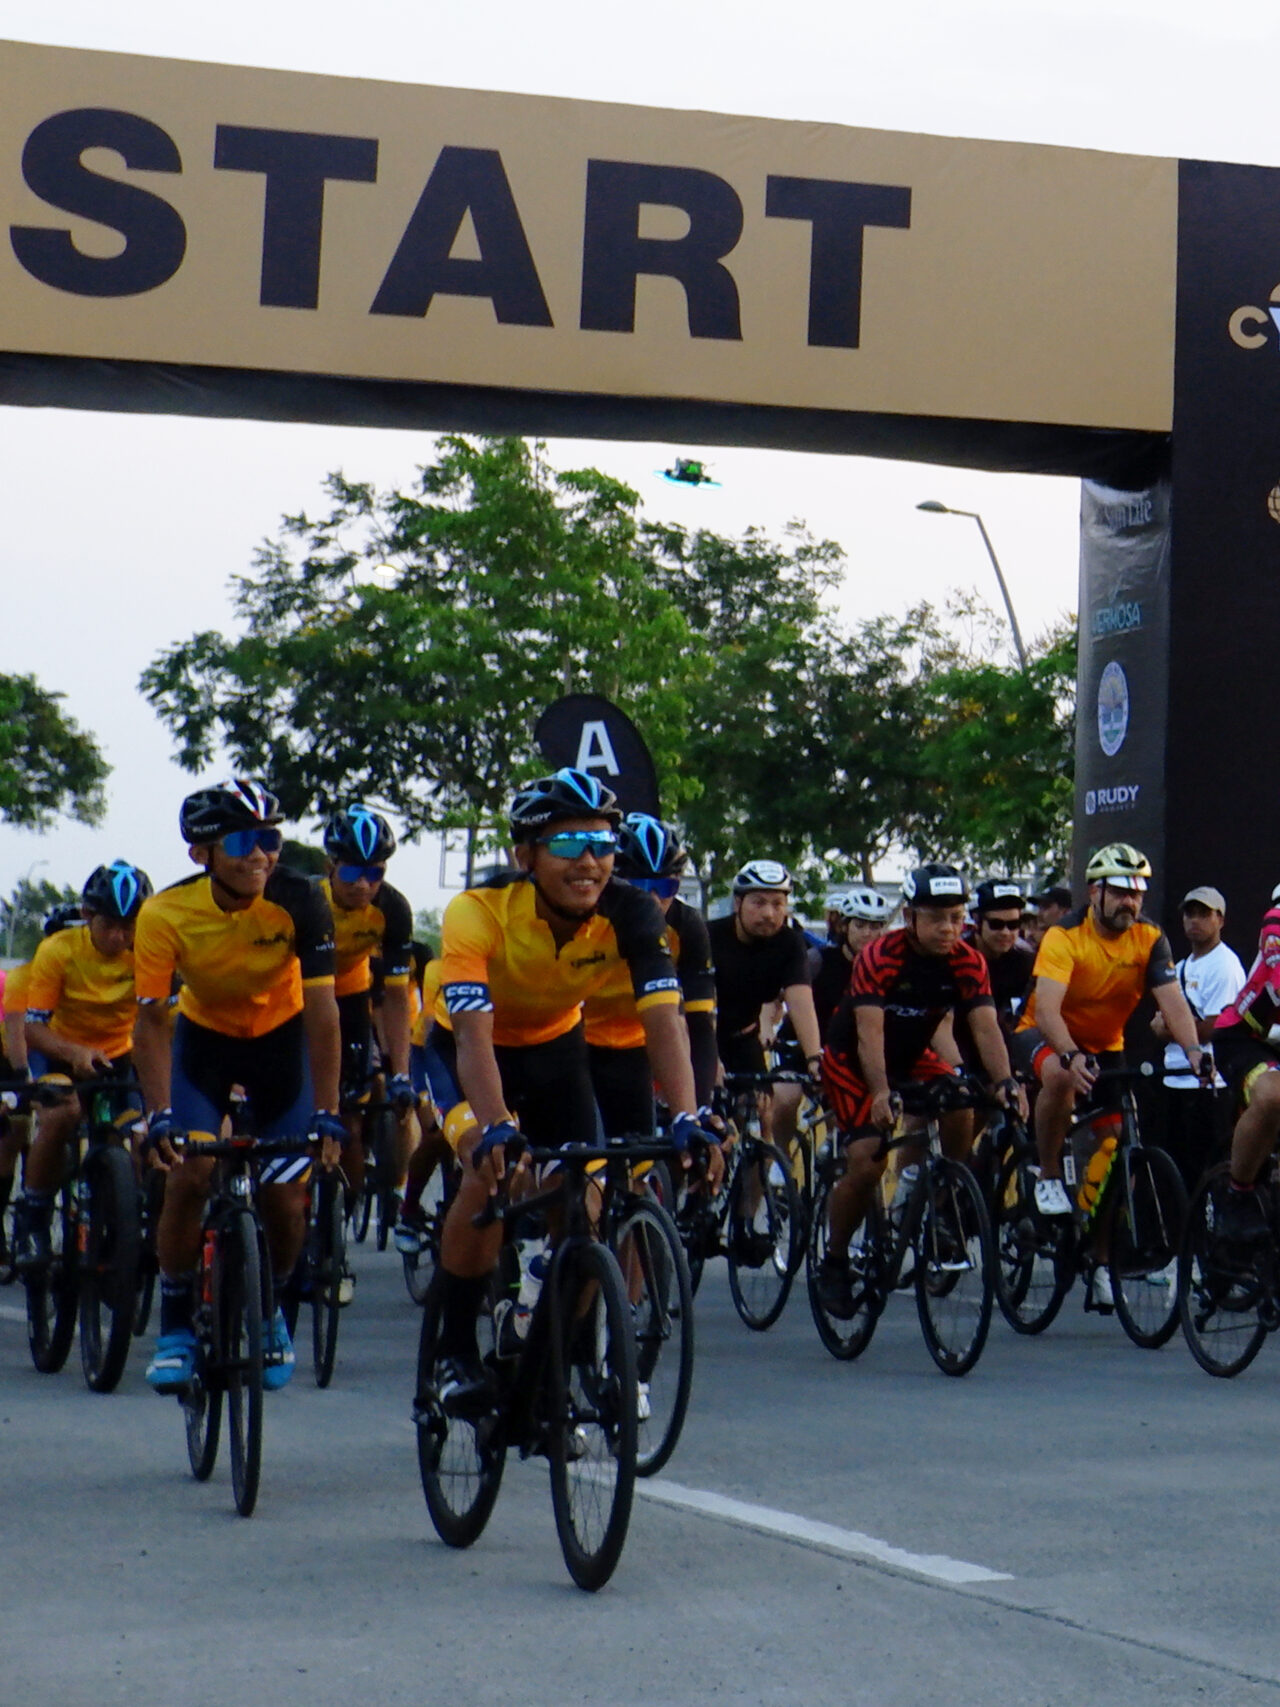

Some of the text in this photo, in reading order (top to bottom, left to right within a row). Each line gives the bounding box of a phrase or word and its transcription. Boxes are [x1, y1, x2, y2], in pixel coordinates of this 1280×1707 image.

[9, 106, 913, 350] START
[576, 720, 620, 776] A
[1097, 785, 1140, 805] RUDY
